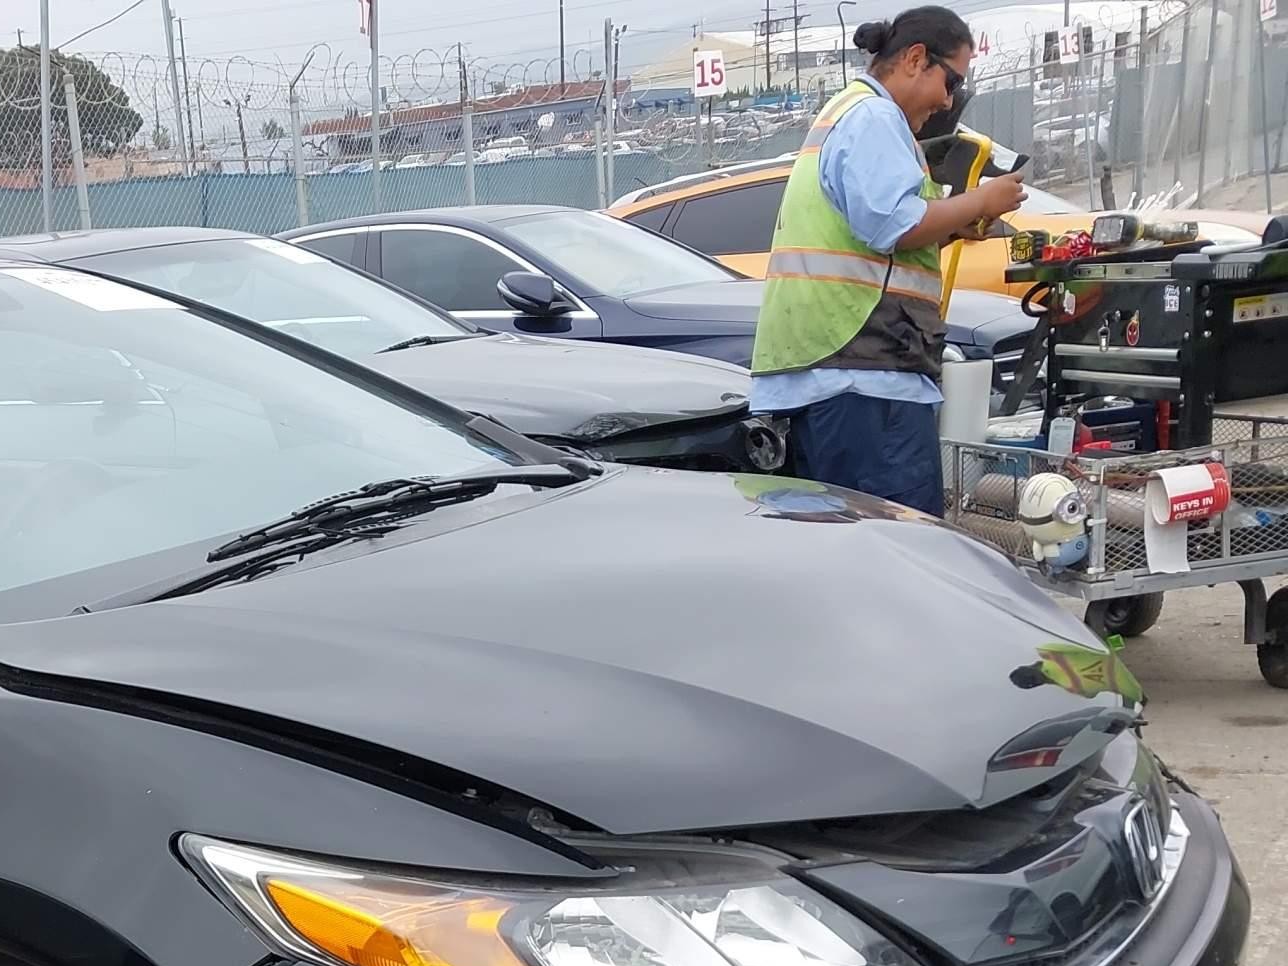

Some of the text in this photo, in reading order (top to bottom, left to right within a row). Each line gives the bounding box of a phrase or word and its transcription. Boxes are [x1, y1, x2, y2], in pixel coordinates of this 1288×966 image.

[1060, 32, 1080, 56] 13
[696, 58, 724, 88] 15
[1173, 496, 1214, 512] KEYS IN
[1174, 507, 1211, 520] OFFICE
